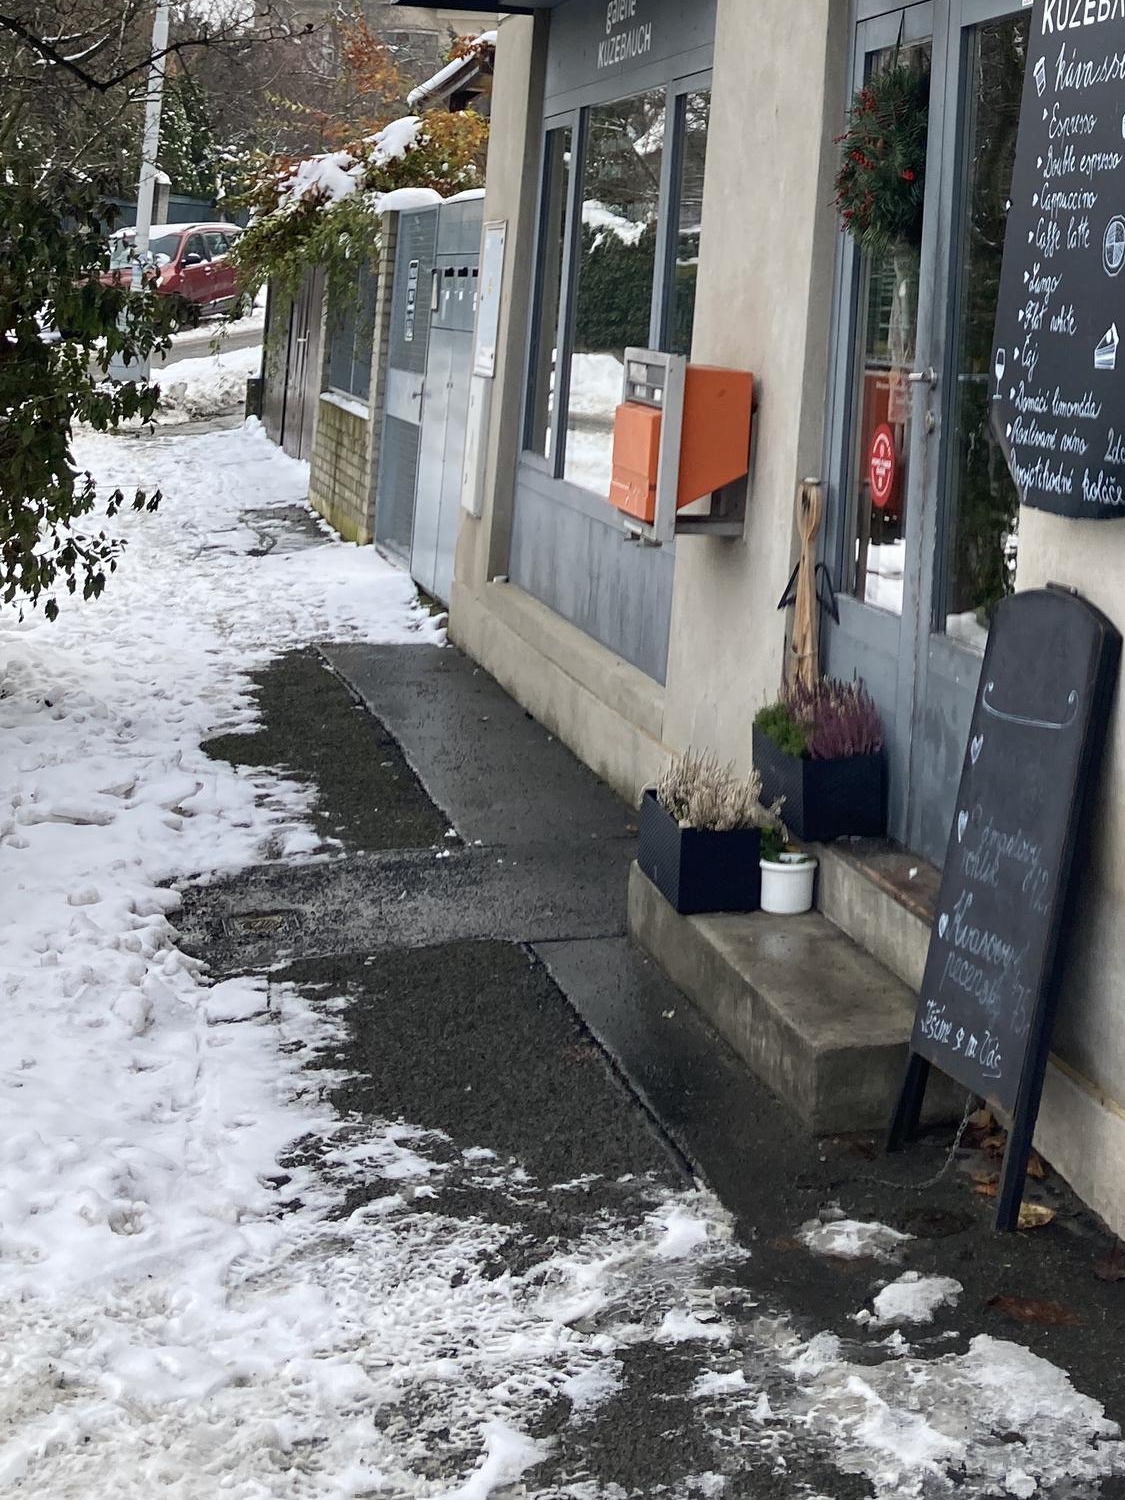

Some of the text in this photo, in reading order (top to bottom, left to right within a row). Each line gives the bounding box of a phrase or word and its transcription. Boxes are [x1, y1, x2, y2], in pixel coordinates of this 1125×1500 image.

[597, 22, 652, 68] KUZEBAUCH
[1048, 102, 1098, 147] Espresso
[1043, 145, 1076, 178] Double
[1079, 151, 1123, 180] espresso
[1040, 182, 1098, 219] Cappuccino
[1066, 216, 1091, 250] latte
[1028, 262, 1063, 305] Lungo
